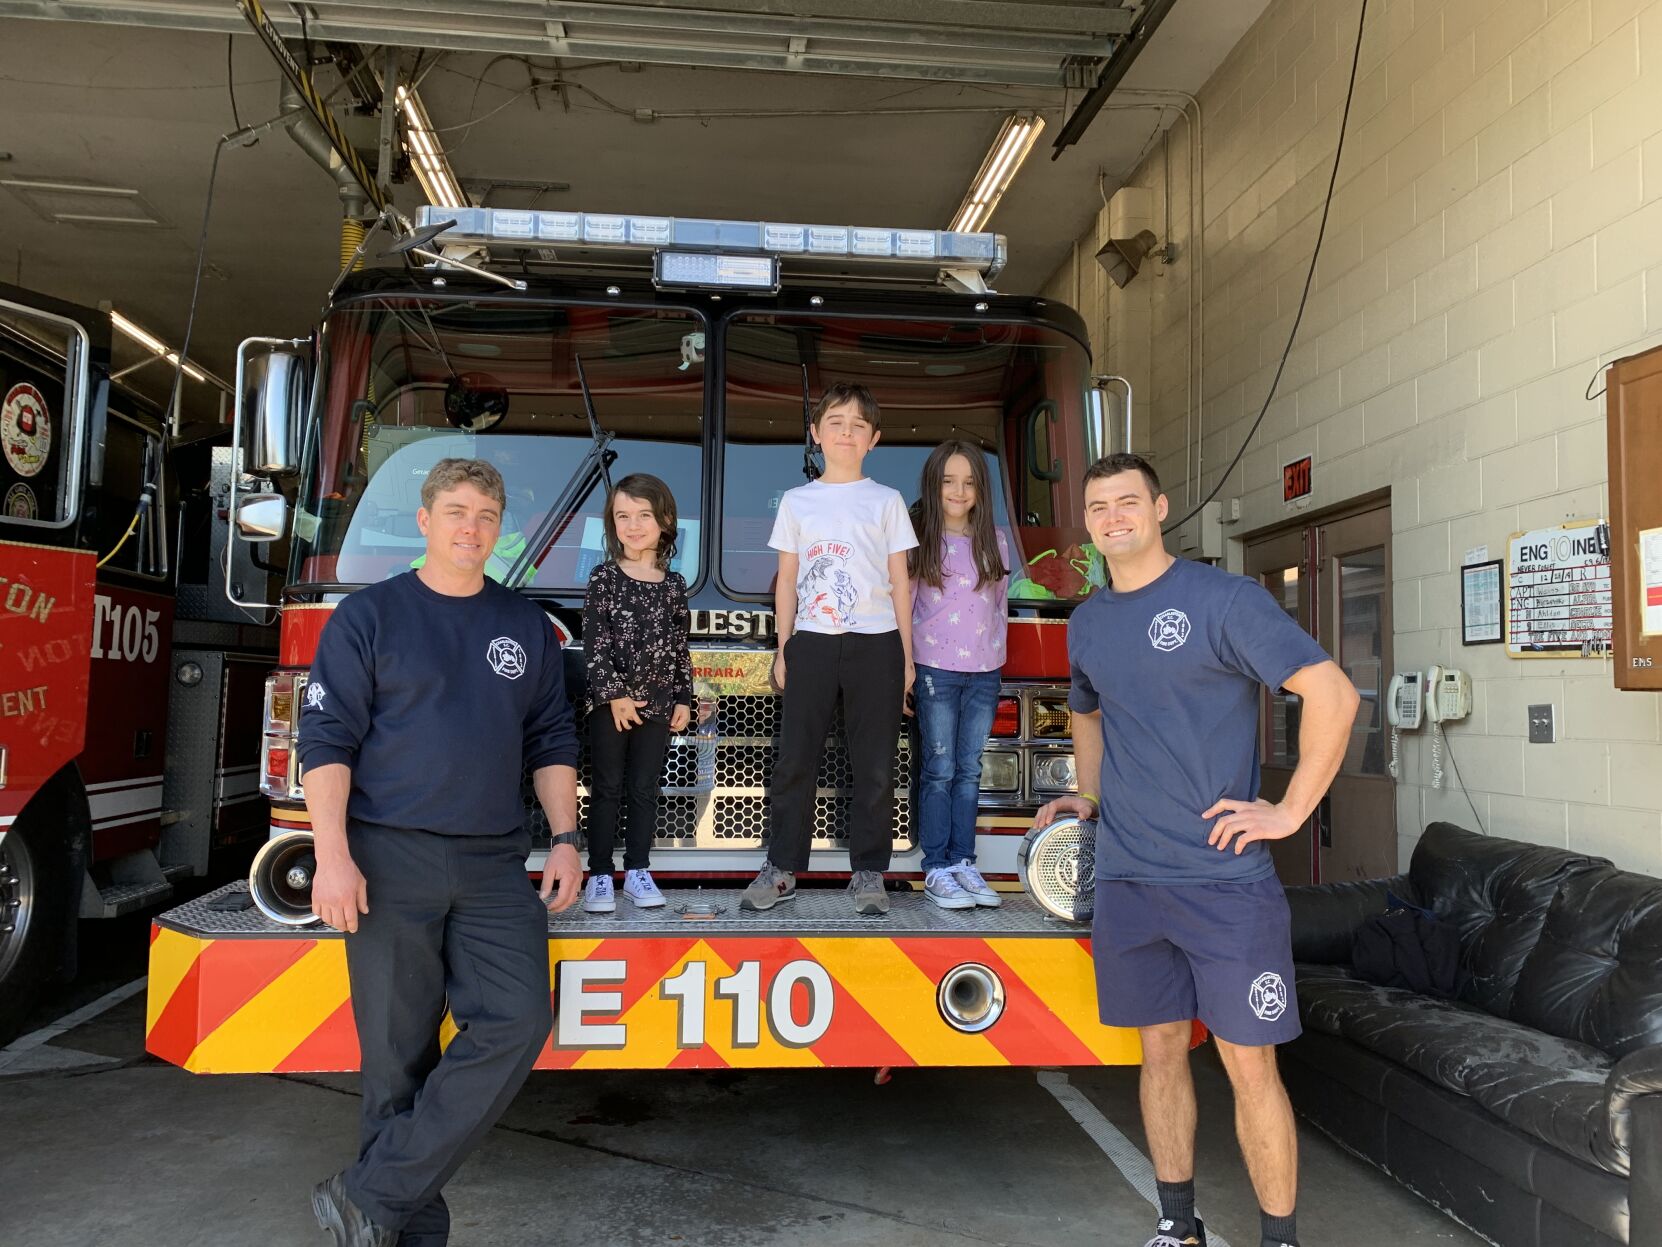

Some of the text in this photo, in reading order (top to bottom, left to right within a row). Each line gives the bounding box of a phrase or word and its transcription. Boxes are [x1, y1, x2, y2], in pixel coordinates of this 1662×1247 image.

[1284, 457, 1311, 501] EXIT
[807, 542, 851, 560] HIGH FIVE!
[1517, 564, 1535, 573] NEVER
[0, 577, 56, 624] ON
[90, 594, 160, 663] T105
[689, 609, 778, 635] LEST
[691, 667, 745, 678] RRARA
[1632, 657, 1652, 667] EMS
[1, 686, 48, 716] ENT
[552, 959, 834, 1050] E 110
